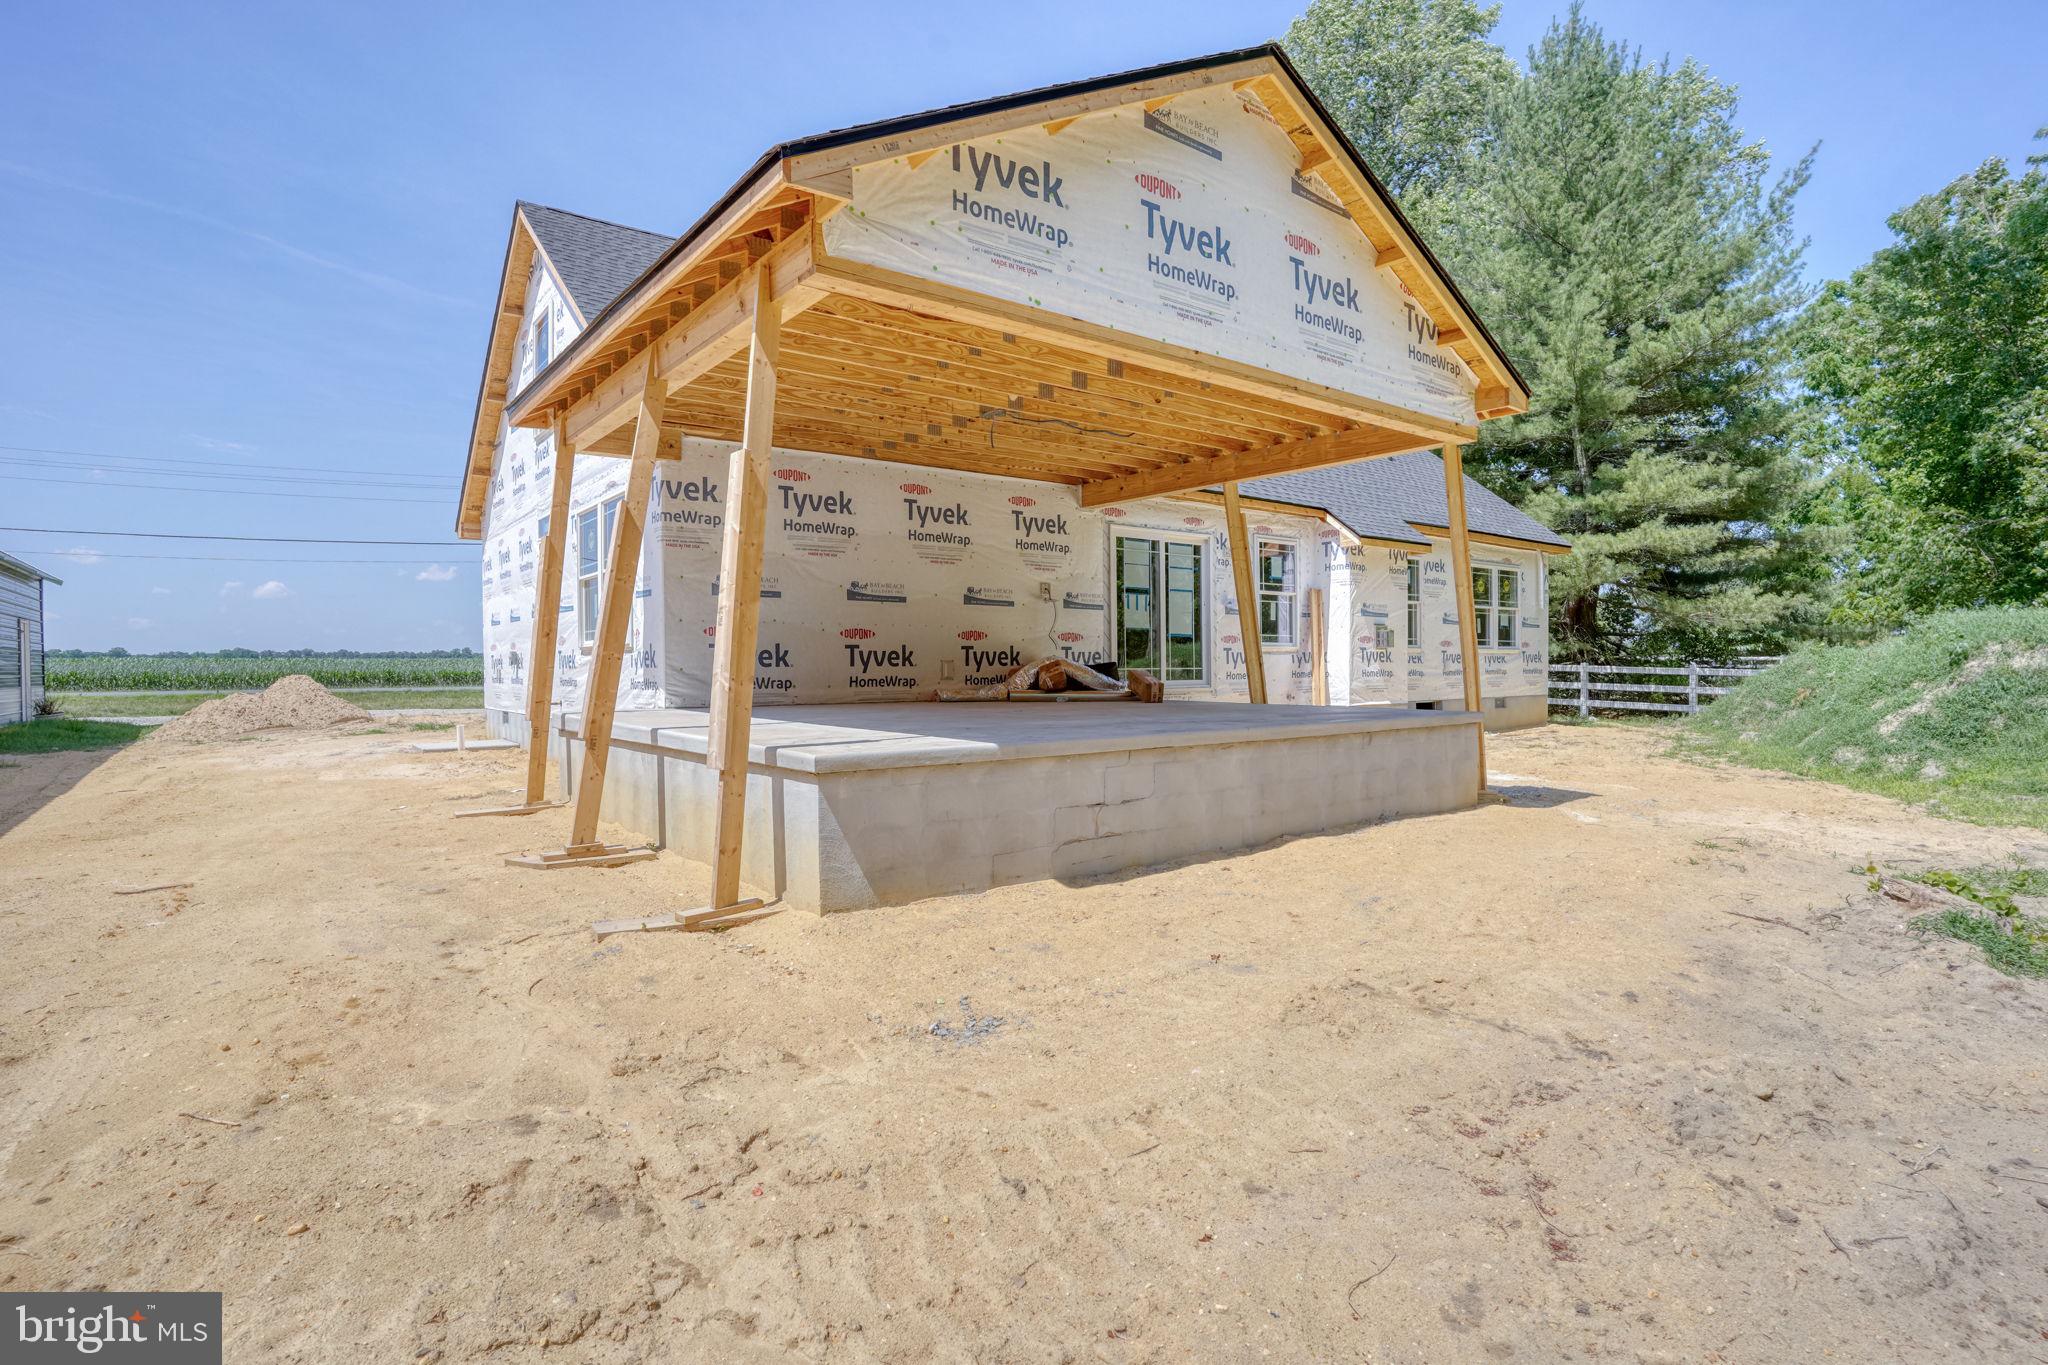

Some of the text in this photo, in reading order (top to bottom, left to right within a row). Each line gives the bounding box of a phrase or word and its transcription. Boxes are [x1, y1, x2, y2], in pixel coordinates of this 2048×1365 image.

[1194, 120, 1219, 139] BEACH
[1140, 174, 1177, 200] DUPONT
[952, 189, 1069, 248] HomeWrap
[1140, 199, 1231, 267] Tyvek
[1288, 233, 1317, 256] DUPONT
[991, 258, 1008, 267] MADE
[1015, 264, 1026, 272] THE
[1027, 268, 1038, 276] USA
[1147, 253, 1236, 302] HomeWrap
[1289, 255, 1360, 313] Tyvek
[1177, 312, 1189, 320] MADE
[1204, 319, 1212, 327] USA
[1295, 303, 1363, 345] HomeWrap
[1404, 301, 1438, 345] Tyv
[1408, 344, 1461, 378] HomeWrap
[511, 458, 526, 485] Tyvek
[776, 469, 808, 482] DUPONT
[651, 476, 719, 507] Tyvek
[903, 483, 929, 495] DUPONT
[778, 485, 854, 517] Tyvek
[1011, 496, 1034, 507] DUPONT
[651, 510, 722, 528] HomeWrap
[903, 498, 969, 528] Tyvek
[1104, 507, 1125, 518] DUPONT
[783, 518, 856, 538] HomeWrap
[1011, 510, 1068, 538] Tyvek
[908, 529, 971, 548] HomeWrap
[1015, 538, 1070, 556] HomeWrap
[1423, 559, 1445, 575] yvek
[844, 628, 873, 639] DUPONT
[961, 631, 985, 641] DUPONT
[1061, 632, 1082, 642] DUPONT
[558, 649, 576, 675] Tyvek
[630, 643, 656, 675] Tyvek
[845, 644, 914, 673] Tyvek
[961, 645, 1021, 672] Tyvek
[1061, 646, 1102, 666] Tyve
[1223, 648, 1246, 669] Tyv
[1360, 647, 1392, 667] Tyvek
[1441, 650, 1462, 668] Tyve
[1522, 650, 1542, 667] Tyvek
[849, 675, 917, 690] HomeWrap
[1226, 672, 1248, 680] Home
[1362, 669, 1393, 678] HomeWrap
